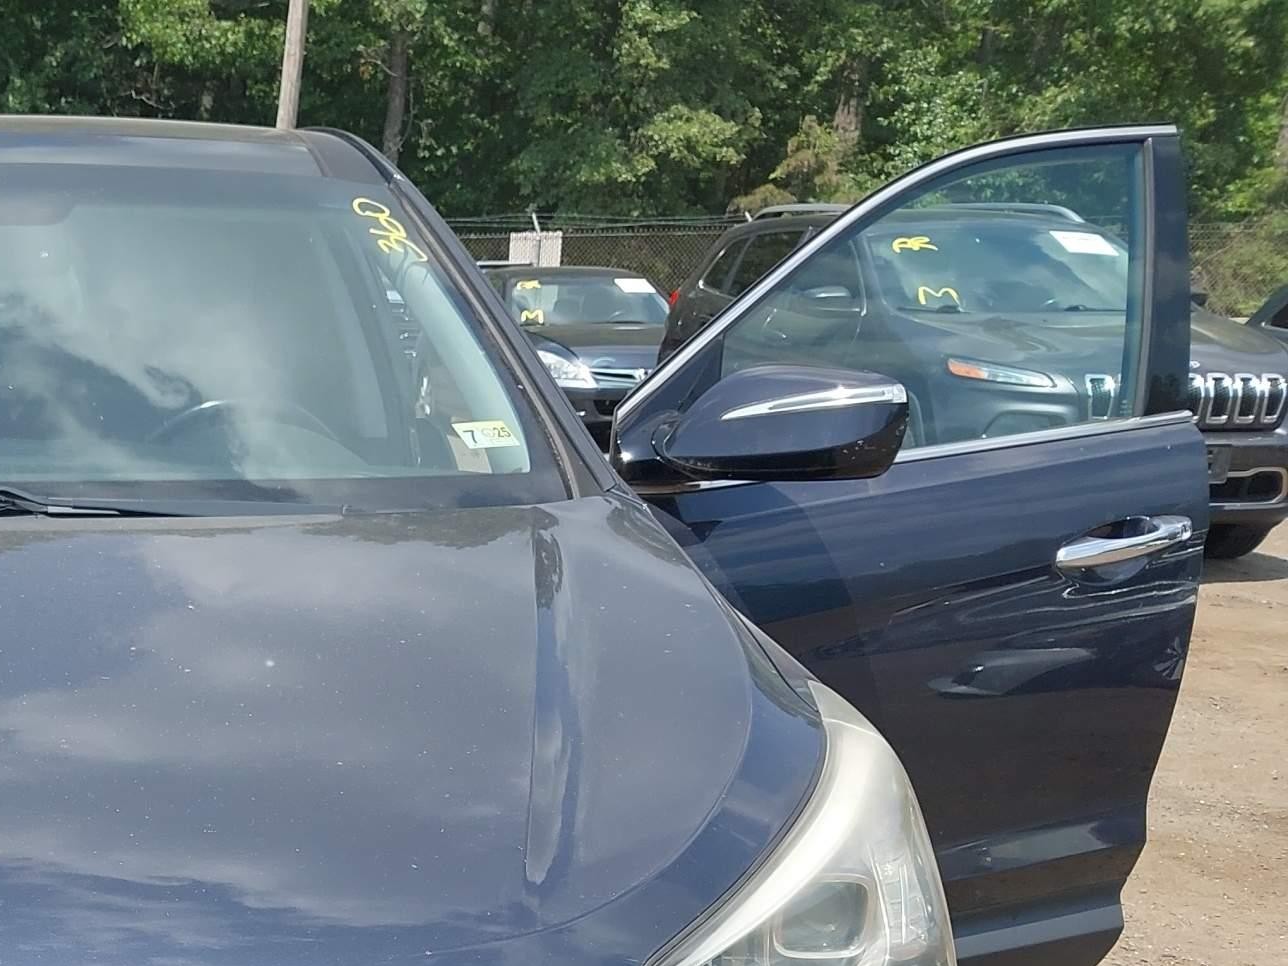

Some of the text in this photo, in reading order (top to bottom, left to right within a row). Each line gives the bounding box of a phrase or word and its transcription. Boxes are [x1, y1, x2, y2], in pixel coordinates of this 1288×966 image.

[520, 309, 545, 325] M
[463, 426, 512, 444] 7 25
